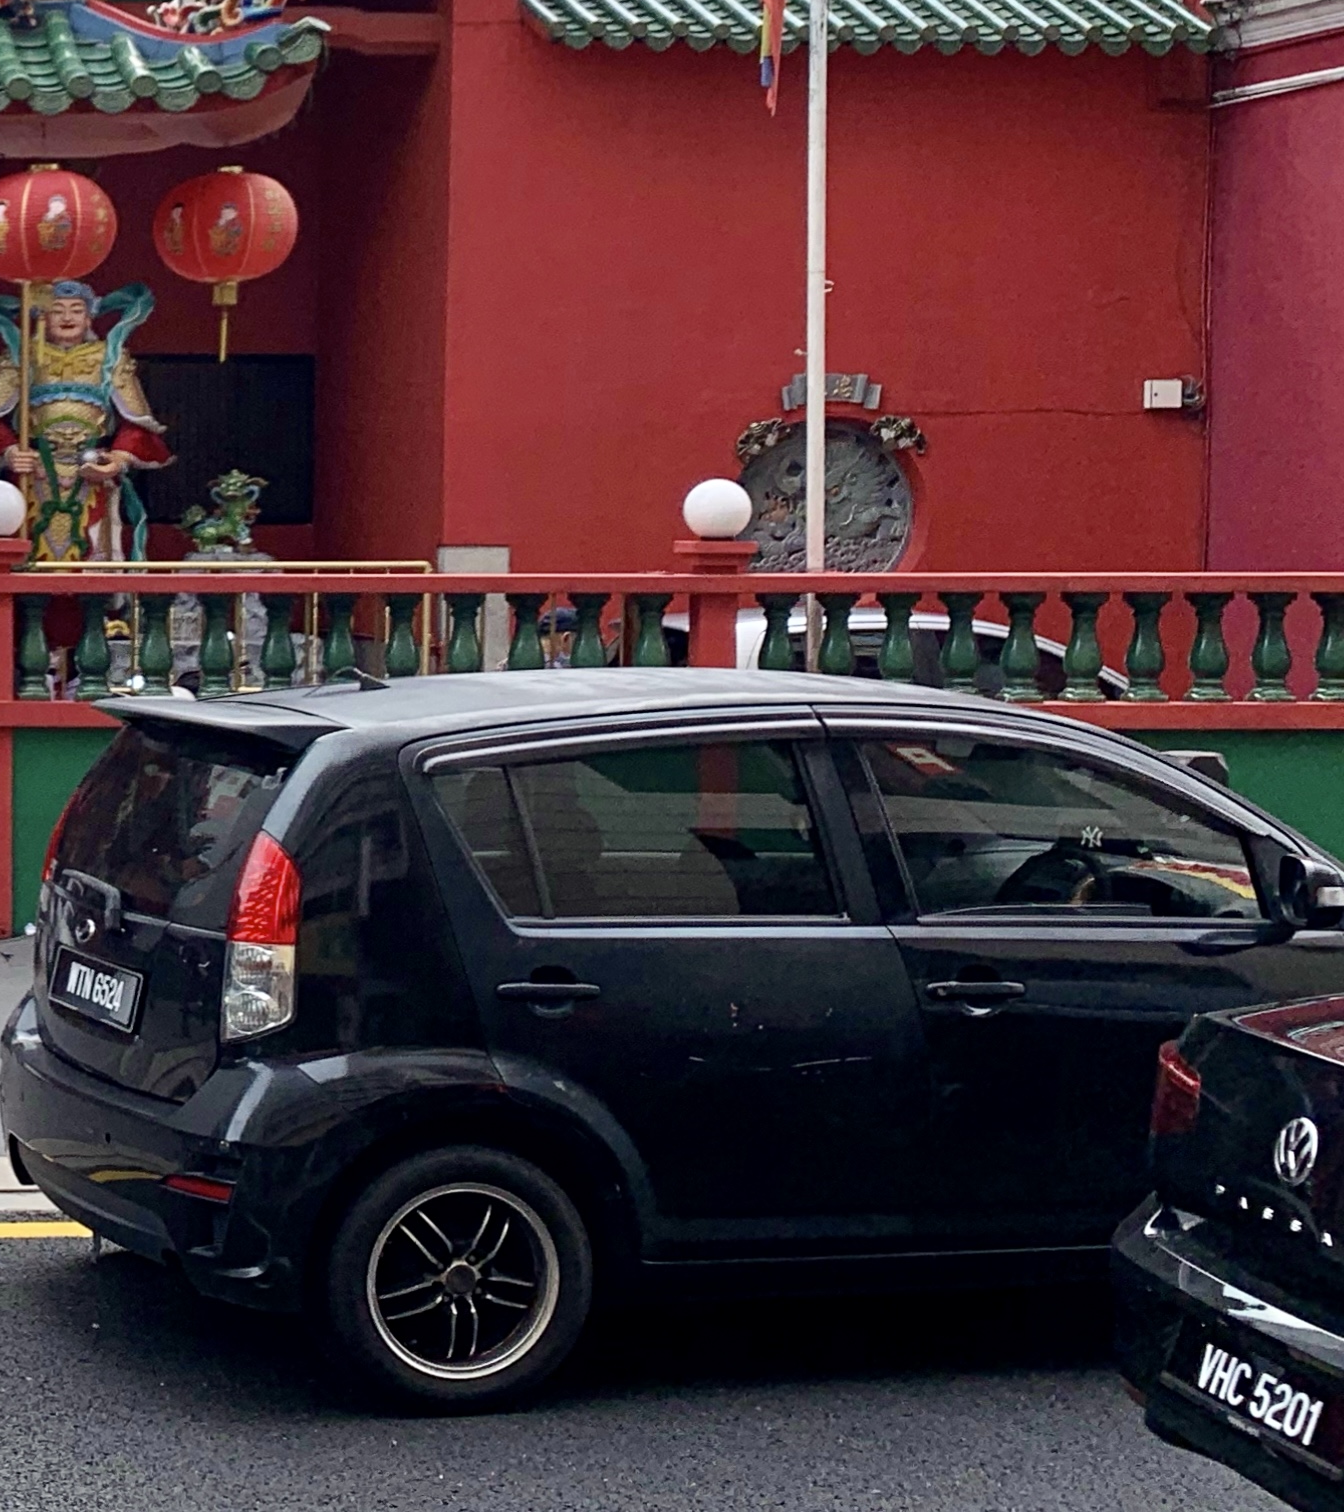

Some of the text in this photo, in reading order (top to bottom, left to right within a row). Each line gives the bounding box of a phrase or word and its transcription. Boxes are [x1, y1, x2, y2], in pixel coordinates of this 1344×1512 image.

[66, 961, 124, 1012] WTN 6524
[1215, 1184, 1333, 1247] PASSA
[1198, 1343, 1324, 1446] VHC 5201
